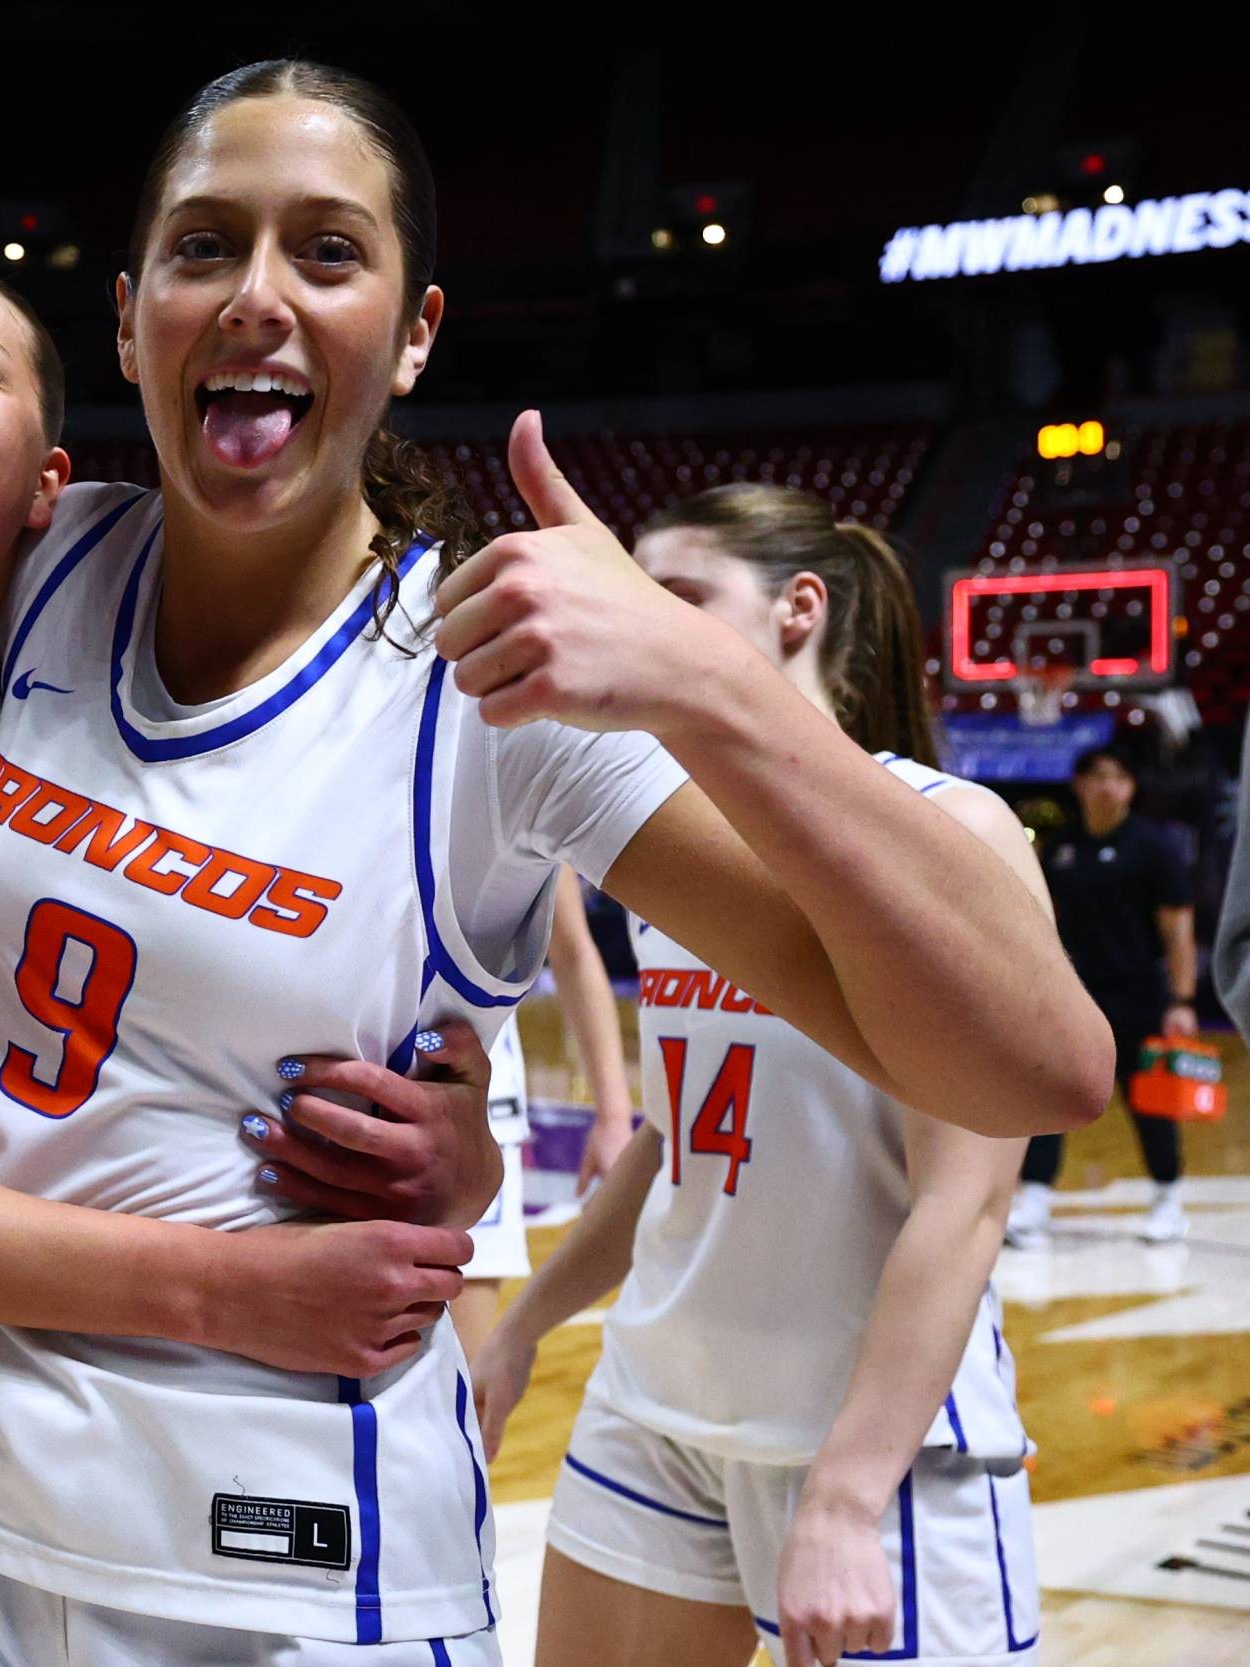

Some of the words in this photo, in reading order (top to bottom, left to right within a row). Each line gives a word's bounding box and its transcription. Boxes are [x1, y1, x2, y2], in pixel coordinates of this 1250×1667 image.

[878, 187, 1250, 283] #MWMADNES
[657, 1036, 756, 1196] 14
[221, 1503, 291, 1518] ENGINEERED
[313, 1522, 328, 1548] L
